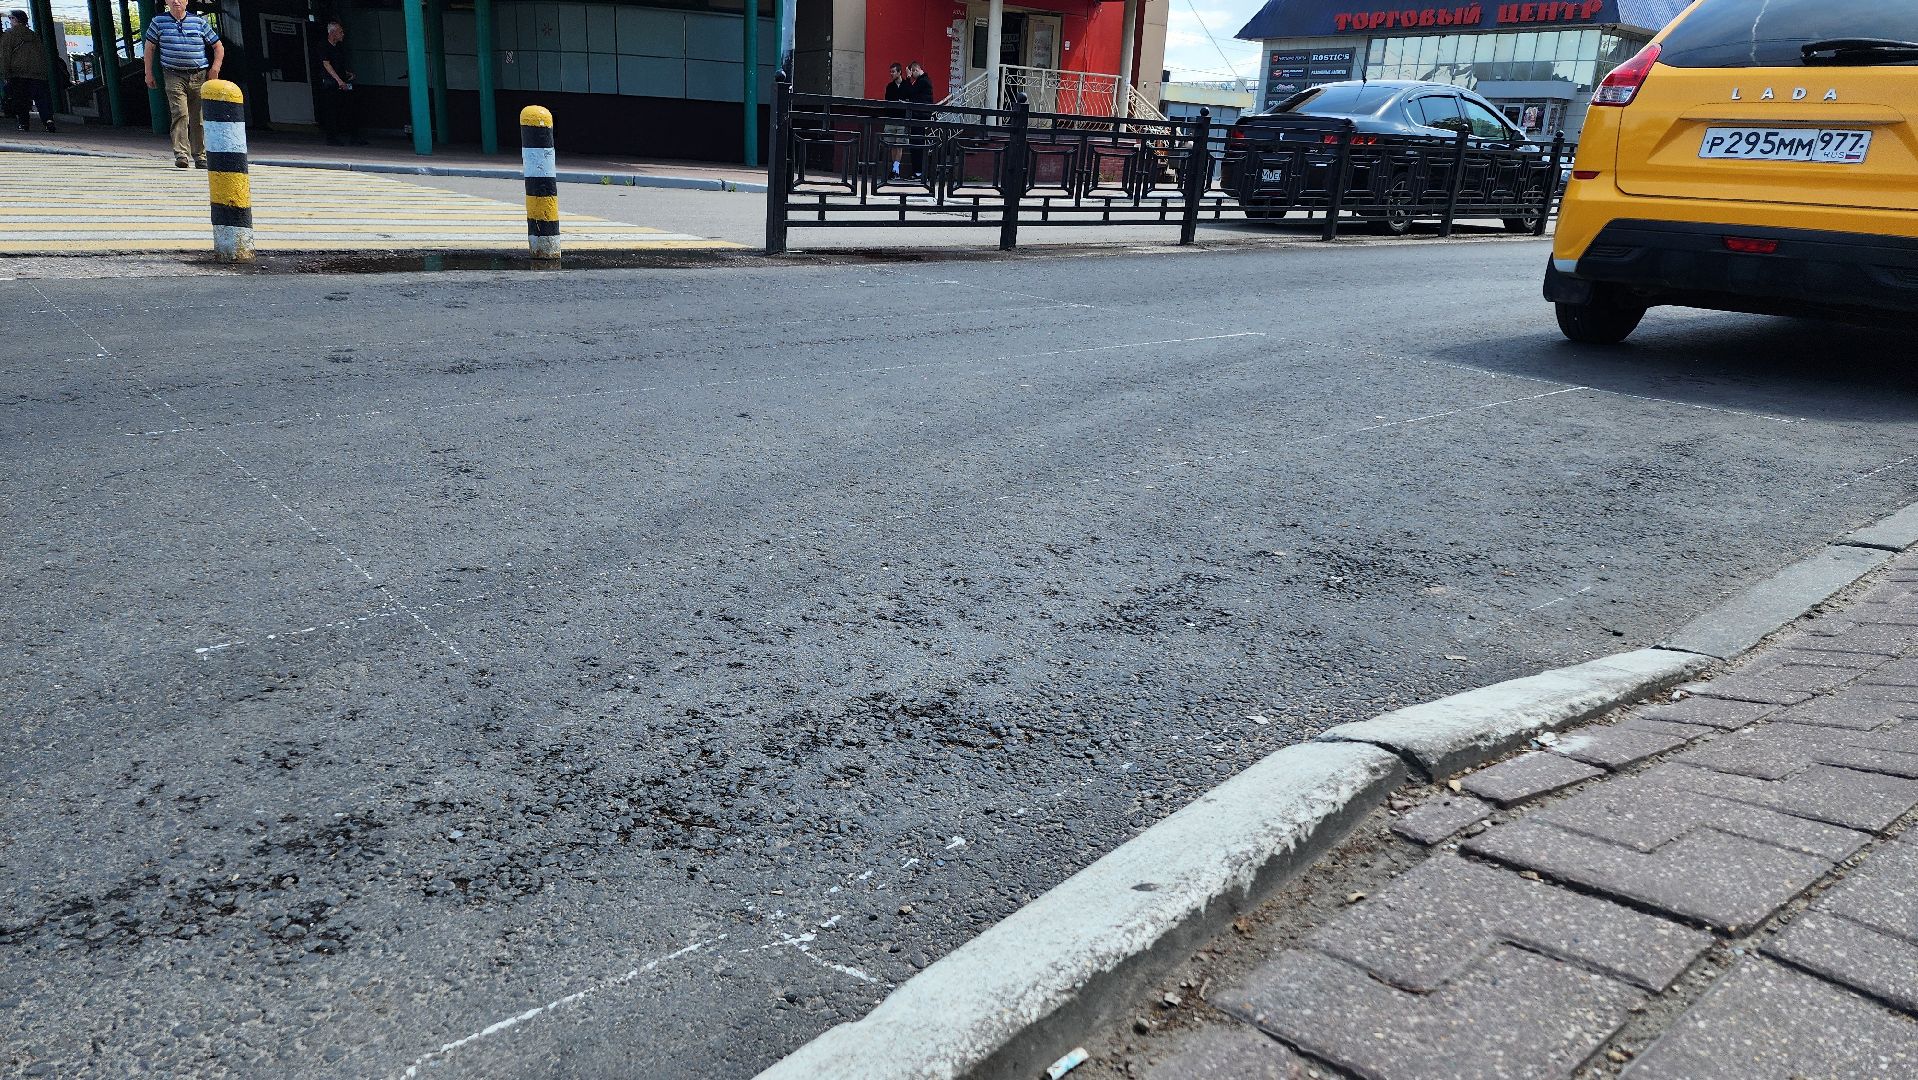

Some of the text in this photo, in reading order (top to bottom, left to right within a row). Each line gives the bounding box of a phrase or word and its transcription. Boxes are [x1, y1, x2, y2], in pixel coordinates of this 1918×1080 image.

[1334, 0, 1603, 31] ТОРГОВЫЙ ЦЕНТР
[1312, 53, 1350, 61] ROSTIC'S
[1731, 87, 1838, 101] LADA
[1819, 132, 1865, 152] 977
[1823, 151, 1845, 159] RUS
